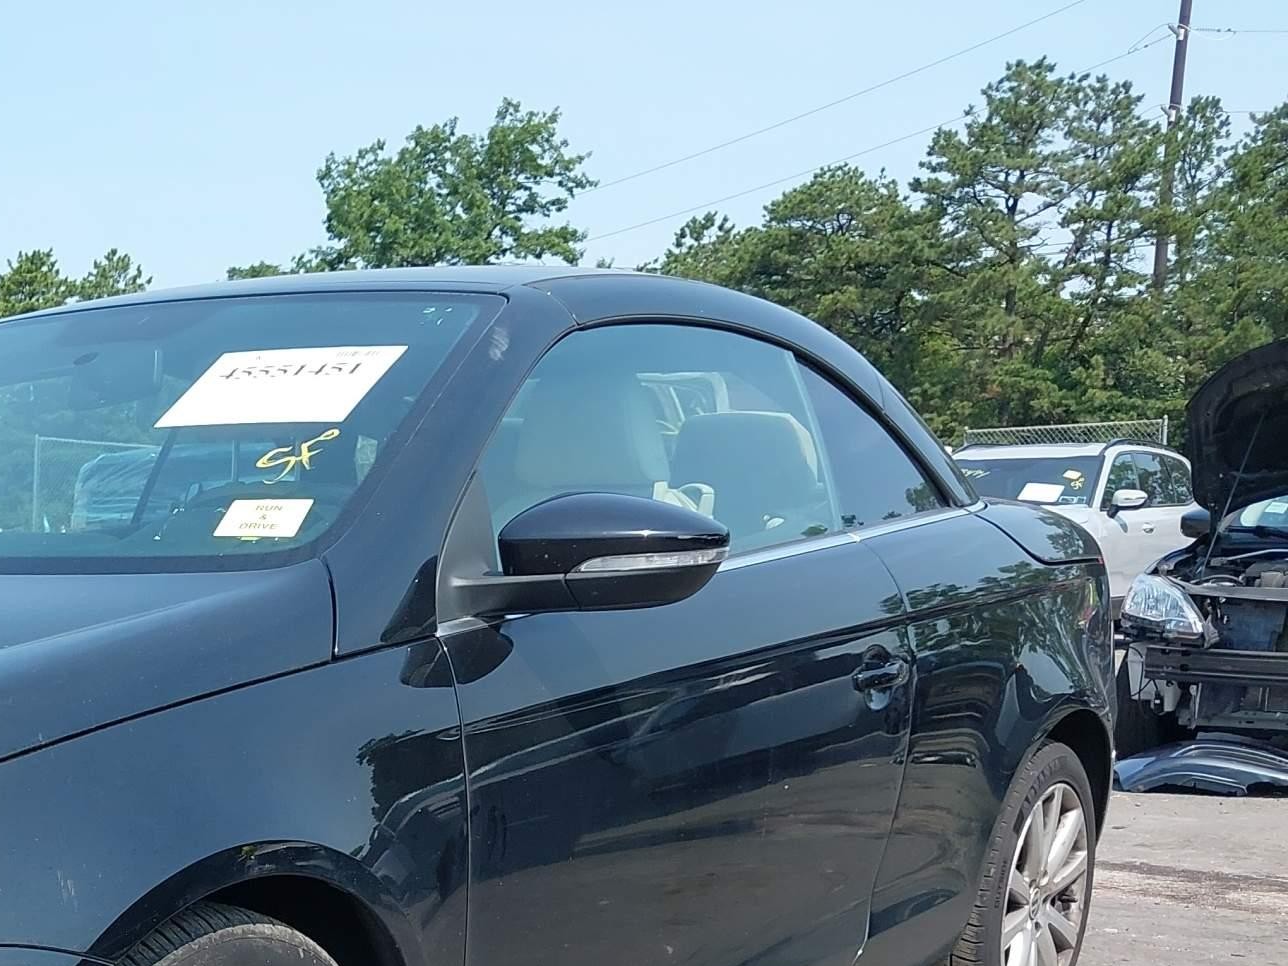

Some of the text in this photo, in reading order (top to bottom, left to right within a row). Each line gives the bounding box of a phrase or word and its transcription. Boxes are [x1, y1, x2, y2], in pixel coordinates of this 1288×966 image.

[220, 362, 363, 380] 45551451
[255, 504, 284, 512] RUN
[239, 522, 281, 531] DRIVE
